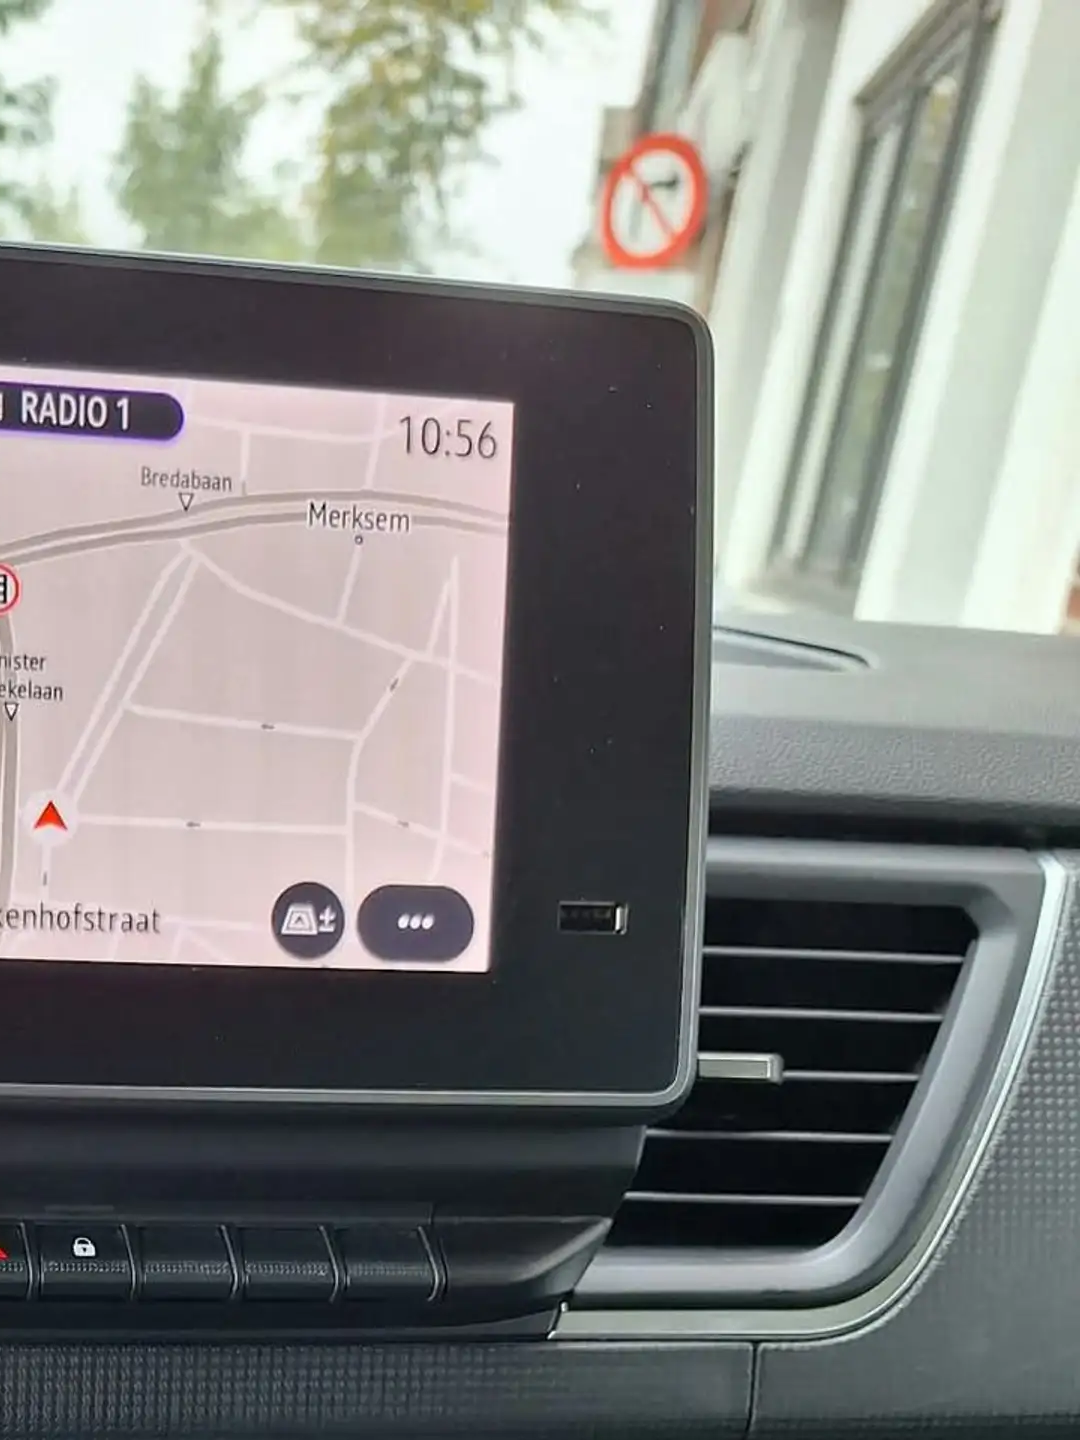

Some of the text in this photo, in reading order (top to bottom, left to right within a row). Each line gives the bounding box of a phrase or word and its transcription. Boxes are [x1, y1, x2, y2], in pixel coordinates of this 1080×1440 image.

[20, 389, 130, 431] RADIO 1
[399, 415, 498, 460] 10:56
[140, 466, 233, 493] Bredabaan
[307, 500, 411, 533] Merksem
